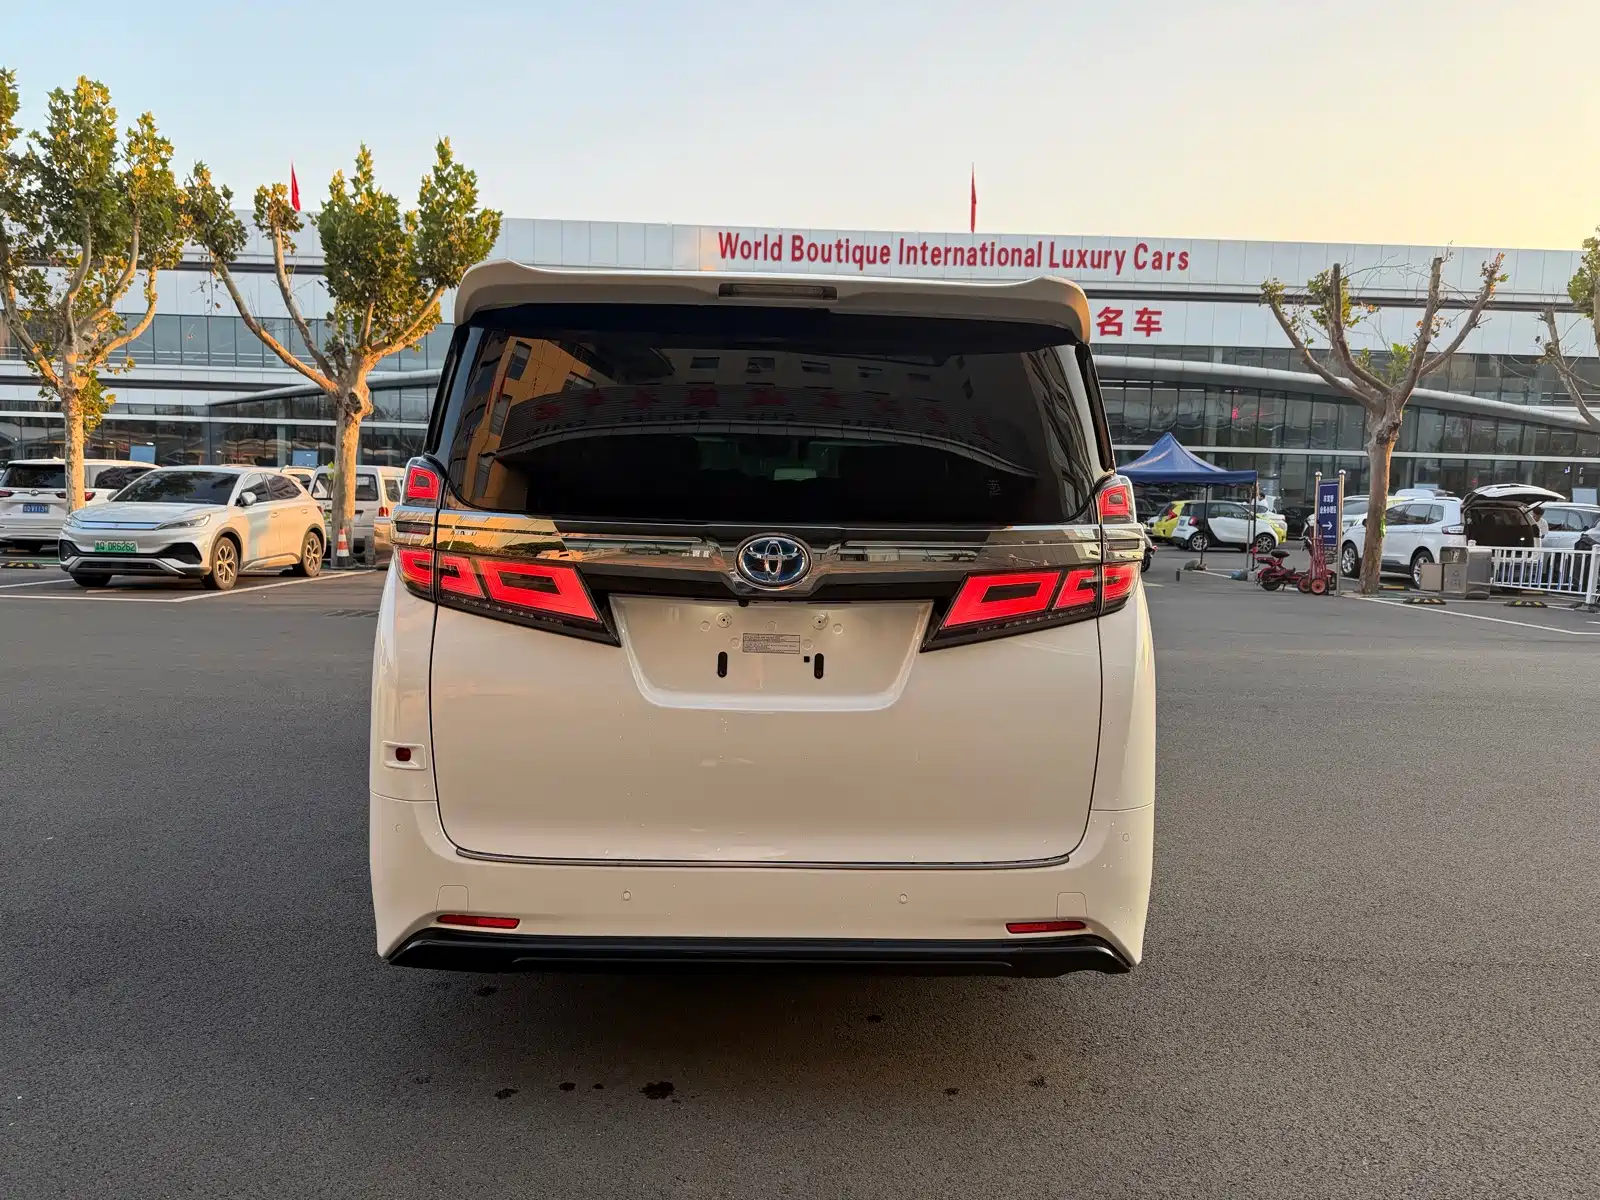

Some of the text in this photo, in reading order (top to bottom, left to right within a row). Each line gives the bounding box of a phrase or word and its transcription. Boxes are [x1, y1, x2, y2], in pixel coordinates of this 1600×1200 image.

[718, 231, 1190, 274] World Boutique International Luxury Cars
[1096, 306, 1163, 337] 名车
